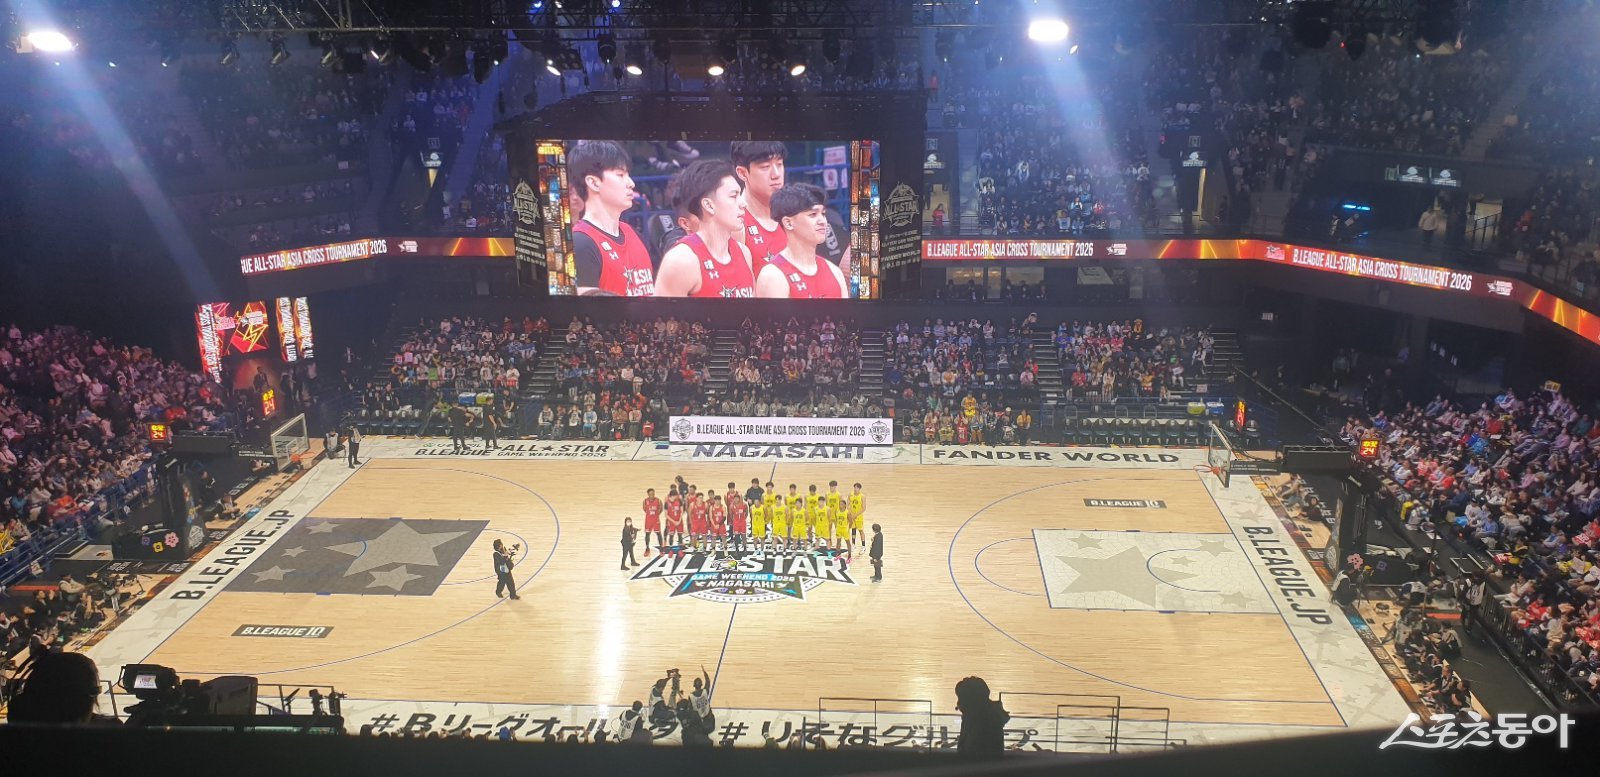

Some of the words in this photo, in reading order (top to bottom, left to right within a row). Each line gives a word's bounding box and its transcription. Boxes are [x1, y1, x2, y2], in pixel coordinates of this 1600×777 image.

[254, 255, 287, 272] ALL-STAR
[288, 253, 303, 266] ASIA
[303, 249, 325, 265] CROSS
[325, 242, 369, 261] TOURNAMENT
[369, 239, 387, 255] 2026
[927, 243, 958, 257] B.LEAGUE
[959, 243, 989, 257] ALL-STAR
[990, 243, 1006, 257] ASIA
[1007, 243, 1028, 257] CROSS
[1029, 243, 1074, 257] TOURNAMENT
[1075, 242, 1094, 257] 2026
[1293, 248, 1325, 267] B.LEAGUE
[1325, 251, 1357, 272] ALL-STAR
[1358, 256, 1374, 276] ASIA
[1375, 260, 1398, 280] CROSS
[1400, 263, 1450, 288] TOURNAMENT
[1450, 272, 1472, 291] 2026
[264, 398, 275, 415] 24
[696, 424, 725, 435] B.LEAGUE
[725, 424, 755, 435] ALL-STAR
[755, 424, 773, 435] GAME
[773, 425, 787, 435] ASIA
[788, 425, 808, 436] CROSS
[808, 425, 848, 436] TOURNAMENT
[849, 425, 866, 436] 2026
[501, 444, 539, 452] ALL
[558, 445, 609, 453] STAR
[933, 450, 1053, 461] FANDER
[1062, 452, 1180, 463] WORLD
[1091, 500, 1143, 508] B.LEAGUE
[170, 509, 294, 600] B.LEAGUE.JP
[1242, 526, 1333, 625] B.LEAGUE.JP
[241, 626, 307, 637] B.LEAGUE
